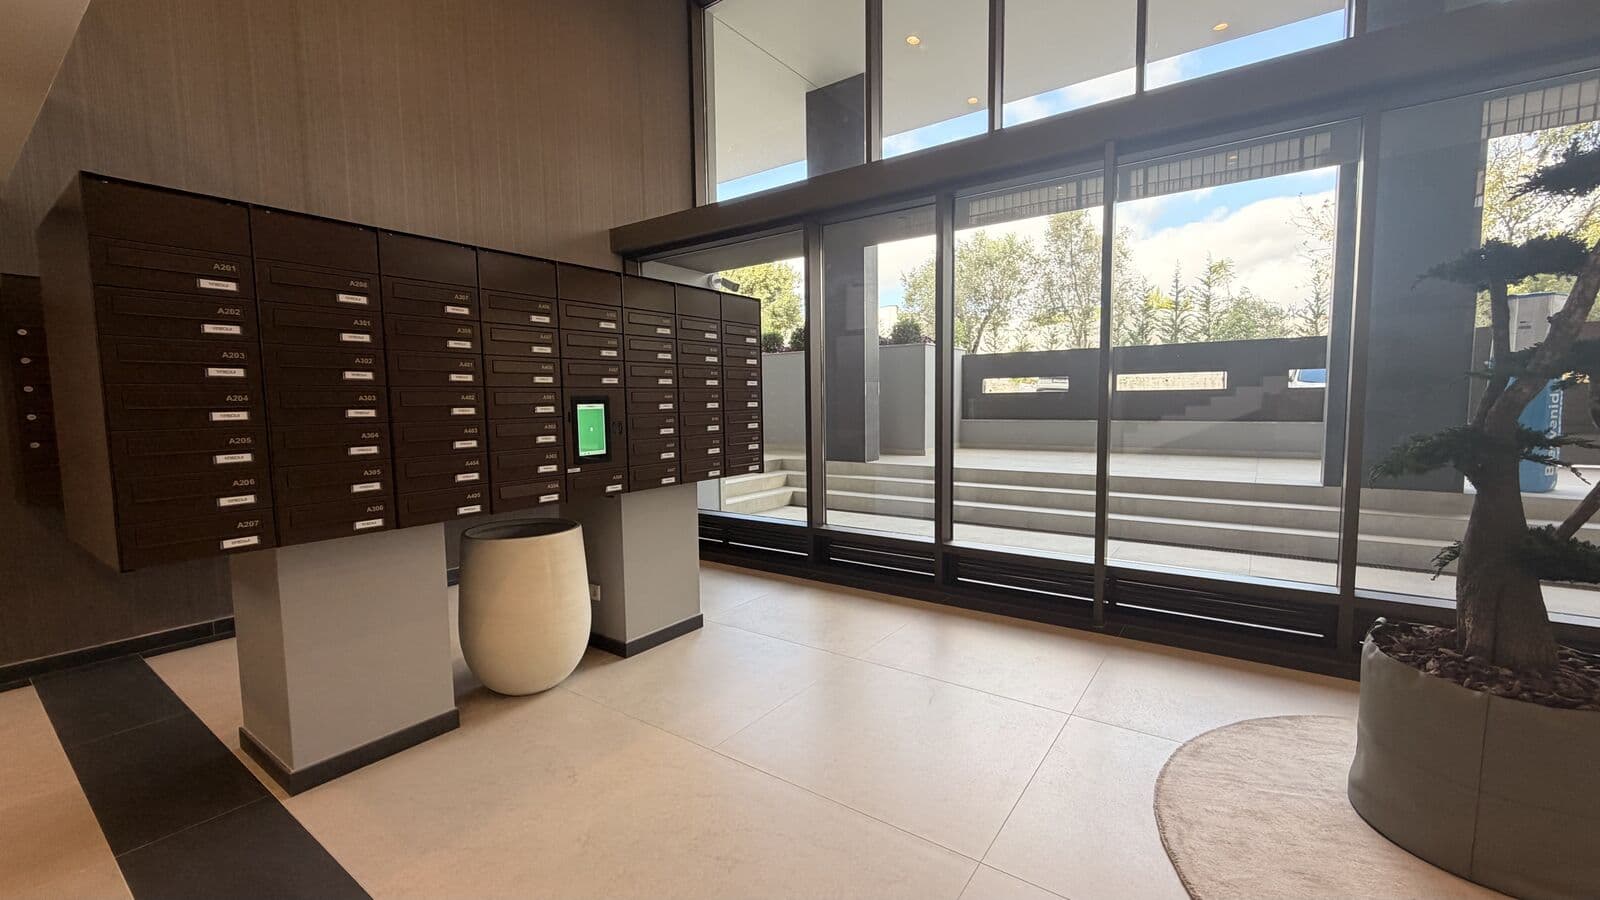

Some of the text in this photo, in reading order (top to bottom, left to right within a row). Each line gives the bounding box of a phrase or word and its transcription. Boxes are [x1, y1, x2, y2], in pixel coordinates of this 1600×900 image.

[213, 263, 236, 272] A201
[217, 307, 240, 316] A202
[1544, 390, 1560, 476] Bevenid
